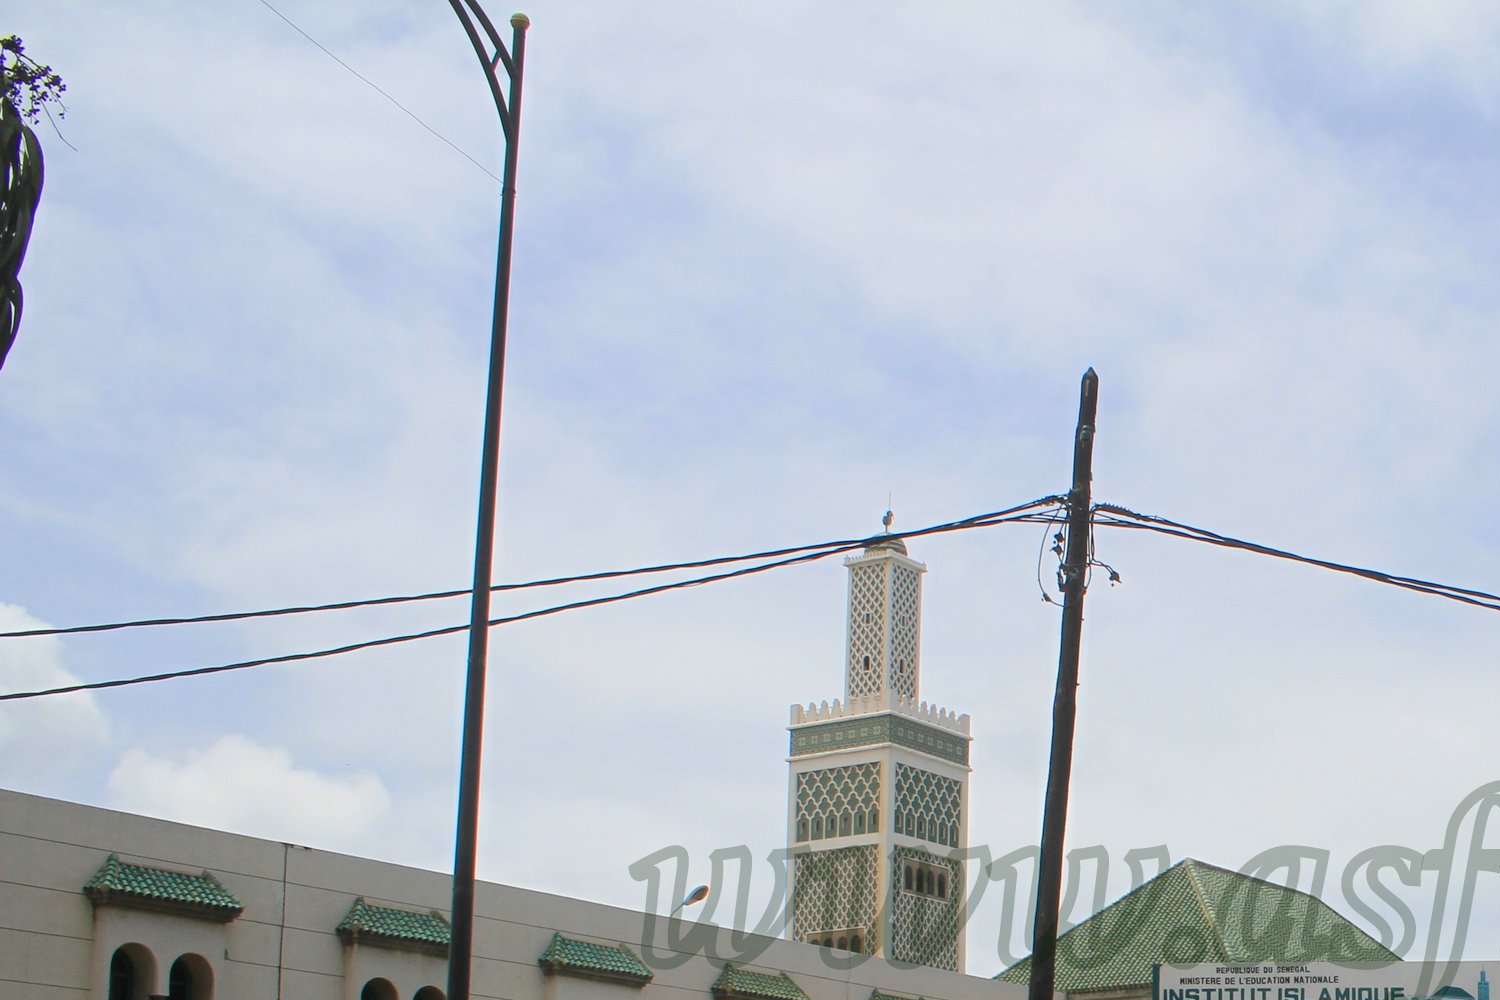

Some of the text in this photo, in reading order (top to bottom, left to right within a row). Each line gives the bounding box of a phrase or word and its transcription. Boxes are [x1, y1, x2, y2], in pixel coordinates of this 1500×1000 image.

[1216, 966, 1260, 974] REPUBLIQUE
[1263, 966, 1273, 974] DU
[1179, 976, 1339, 985] MINISTERE DE L'EDUCATION NATIONALE
